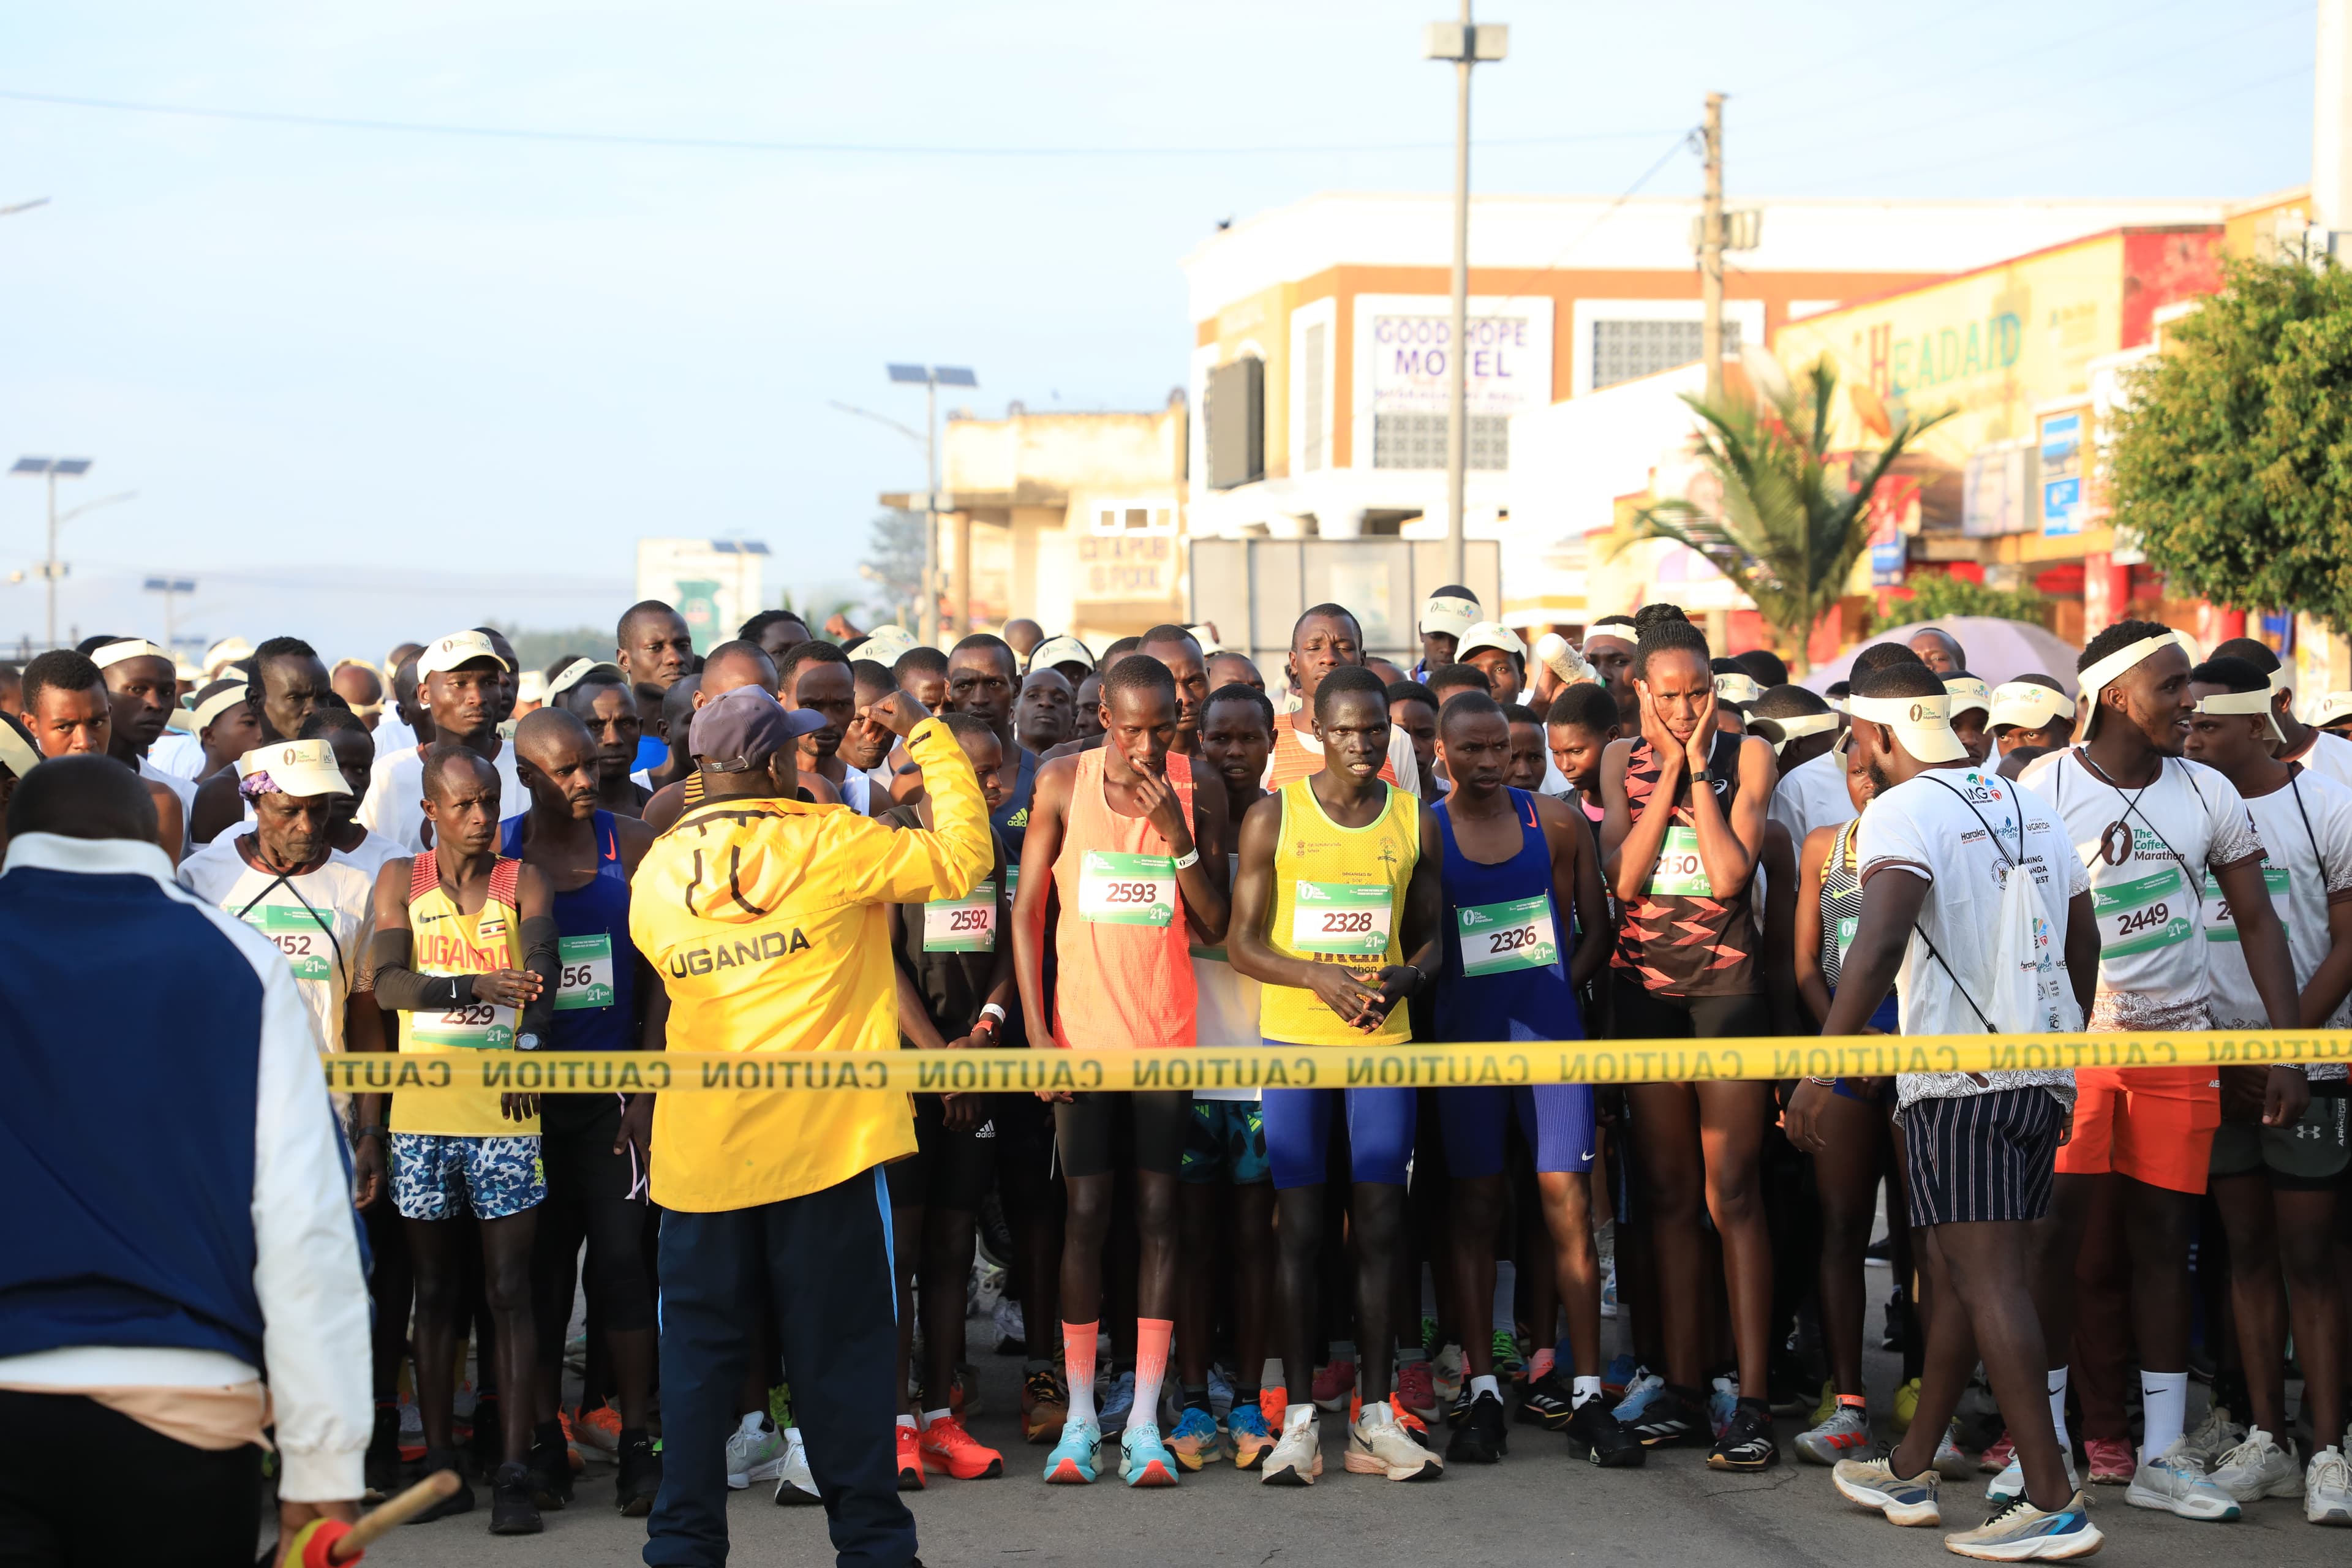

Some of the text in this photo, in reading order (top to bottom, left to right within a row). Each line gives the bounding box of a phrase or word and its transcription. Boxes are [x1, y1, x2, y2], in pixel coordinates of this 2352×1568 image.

[1378, 320, 1450, 344] GOOD
[1395, 349, 1511, 377] MOEL
[1871, 314, 2021, 398] HEADAID
[1961, 829, 1986, 841] Haraka
[2133, 829, 2152, 839] The
[2134, 840, 2167, 851] Coffee
[2135, 851, 2185, 861] Marathon
[1106, 883, 1157, 903] 2593
[950, 910, 987, 931] 2592
[1322, 912, 1373, 932] 2328
[2117, 903, 2169, 936] 2449
[270, 935, 311, 955] 152
[1489, 925, 1537, 954] 2326
[418, 934, 513, 971] UGANDA
[670, 927, 812, 979] UGANDA
[440, 1005, 496, 1025] 2329
